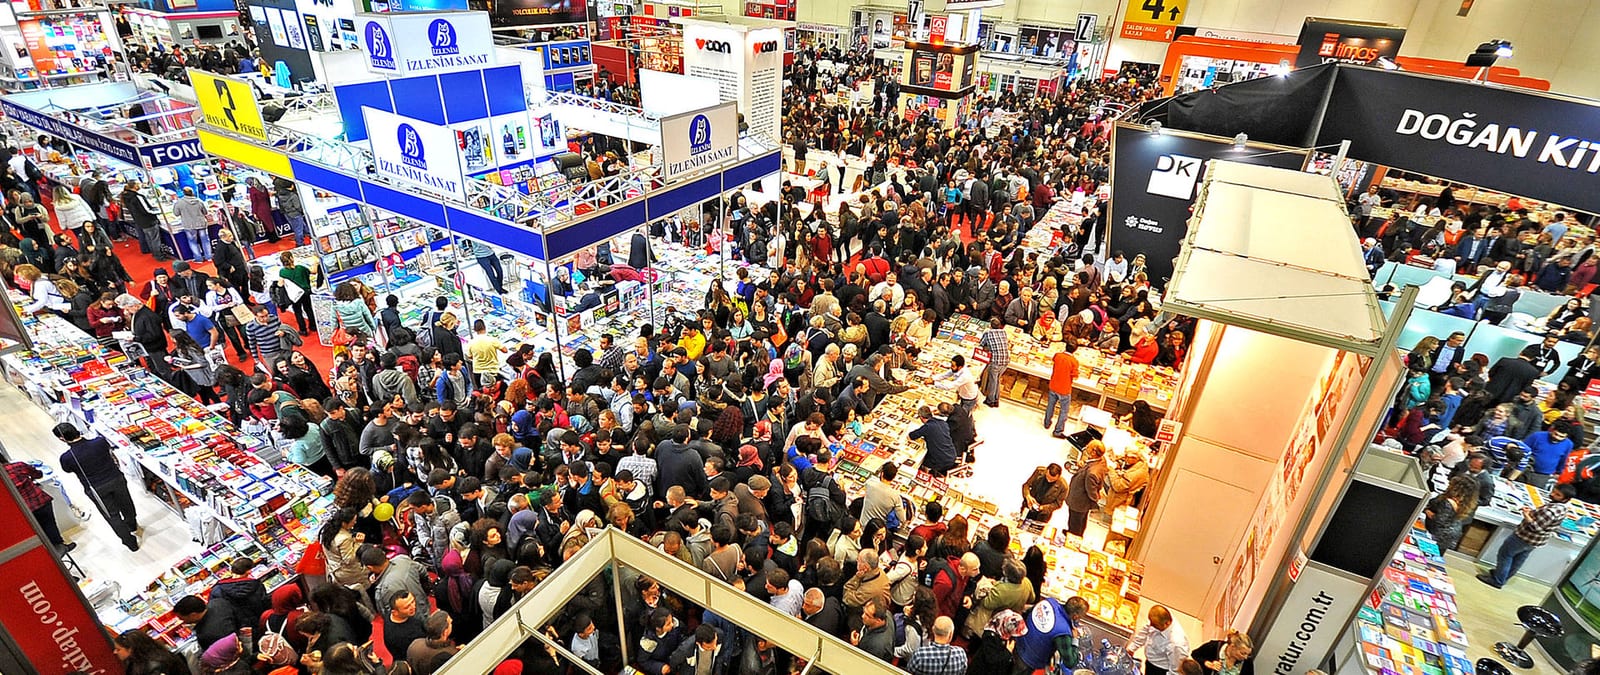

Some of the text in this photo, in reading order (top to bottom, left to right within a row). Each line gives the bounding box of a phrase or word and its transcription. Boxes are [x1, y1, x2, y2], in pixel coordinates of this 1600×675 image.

[1142, 0, 1165, 20] 4
[406, 53, 488, 71] İZLENİM SANAT
[1335, 42, 1379, 64] timaş
[206, 114, 229, 128] HAYAL
[240, 123, 264, 138] PEREST
[1396, 109, 1537, 158] DOĞAN
[669, 146, 733, 176] İZLENİM SANAT
[379, 156, 457, 193] İZLENİM SANAT
